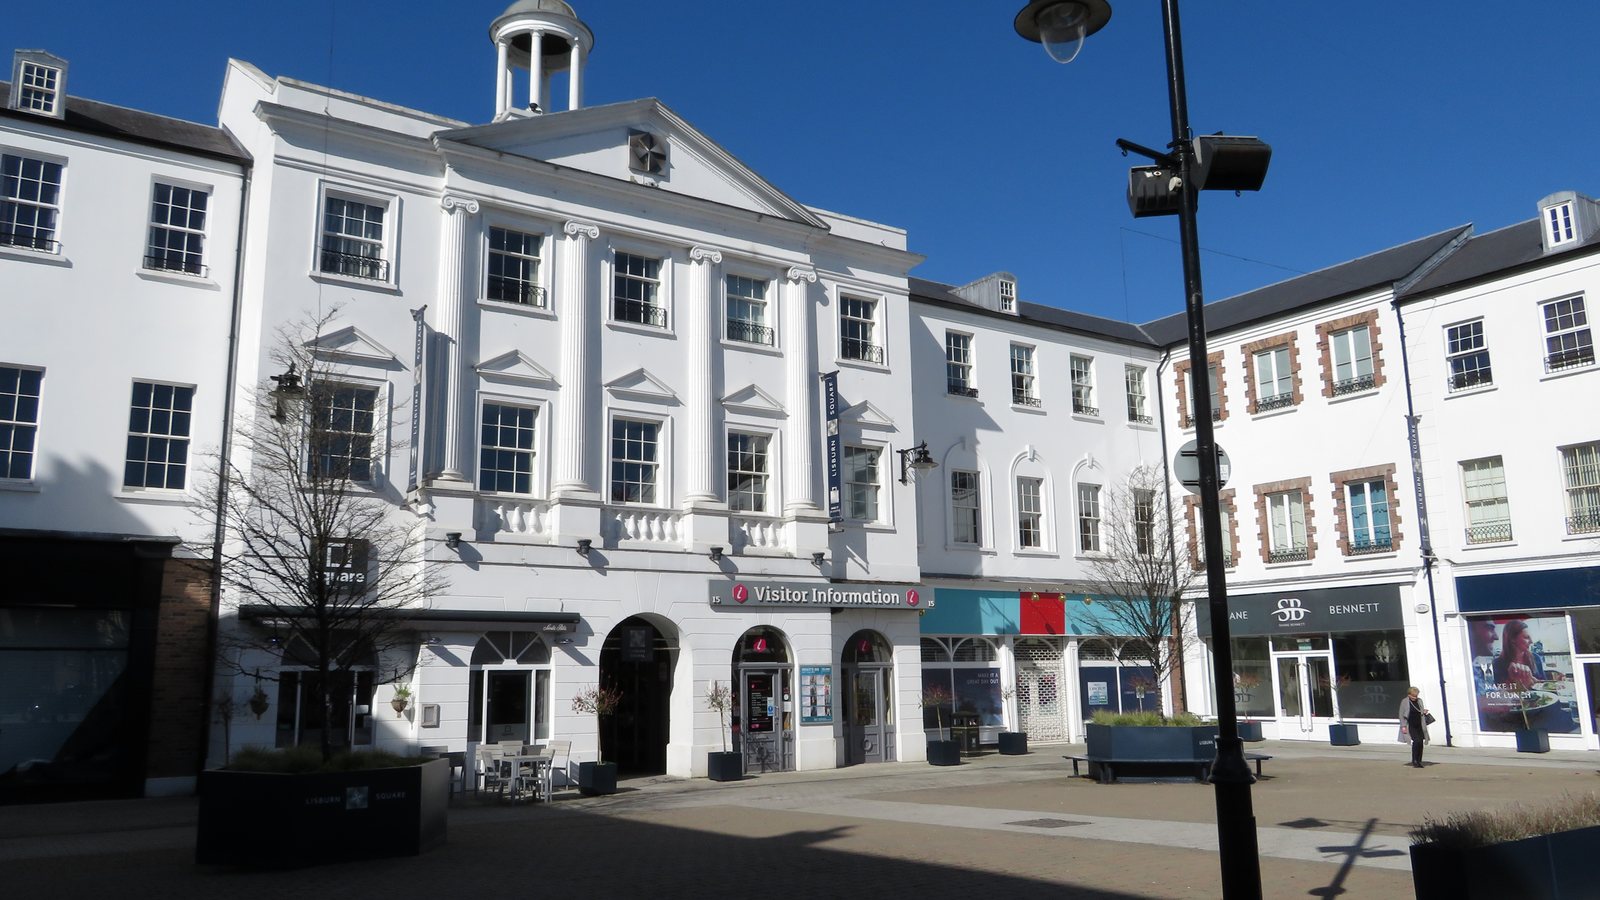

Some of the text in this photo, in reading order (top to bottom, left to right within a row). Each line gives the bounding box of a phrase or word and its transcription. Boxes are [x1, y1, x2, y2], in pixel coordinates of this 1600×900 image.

[712, 596, 721, 604] 15
[754, 586, 900, 605] Visitor Information
[1329, 602, 1380, 614] BENNETT
[1229, 610, 1249, 620] ANE
[1486, 691, 1501, 699] FOR
[375, 791, 407, 801] SQUARE
